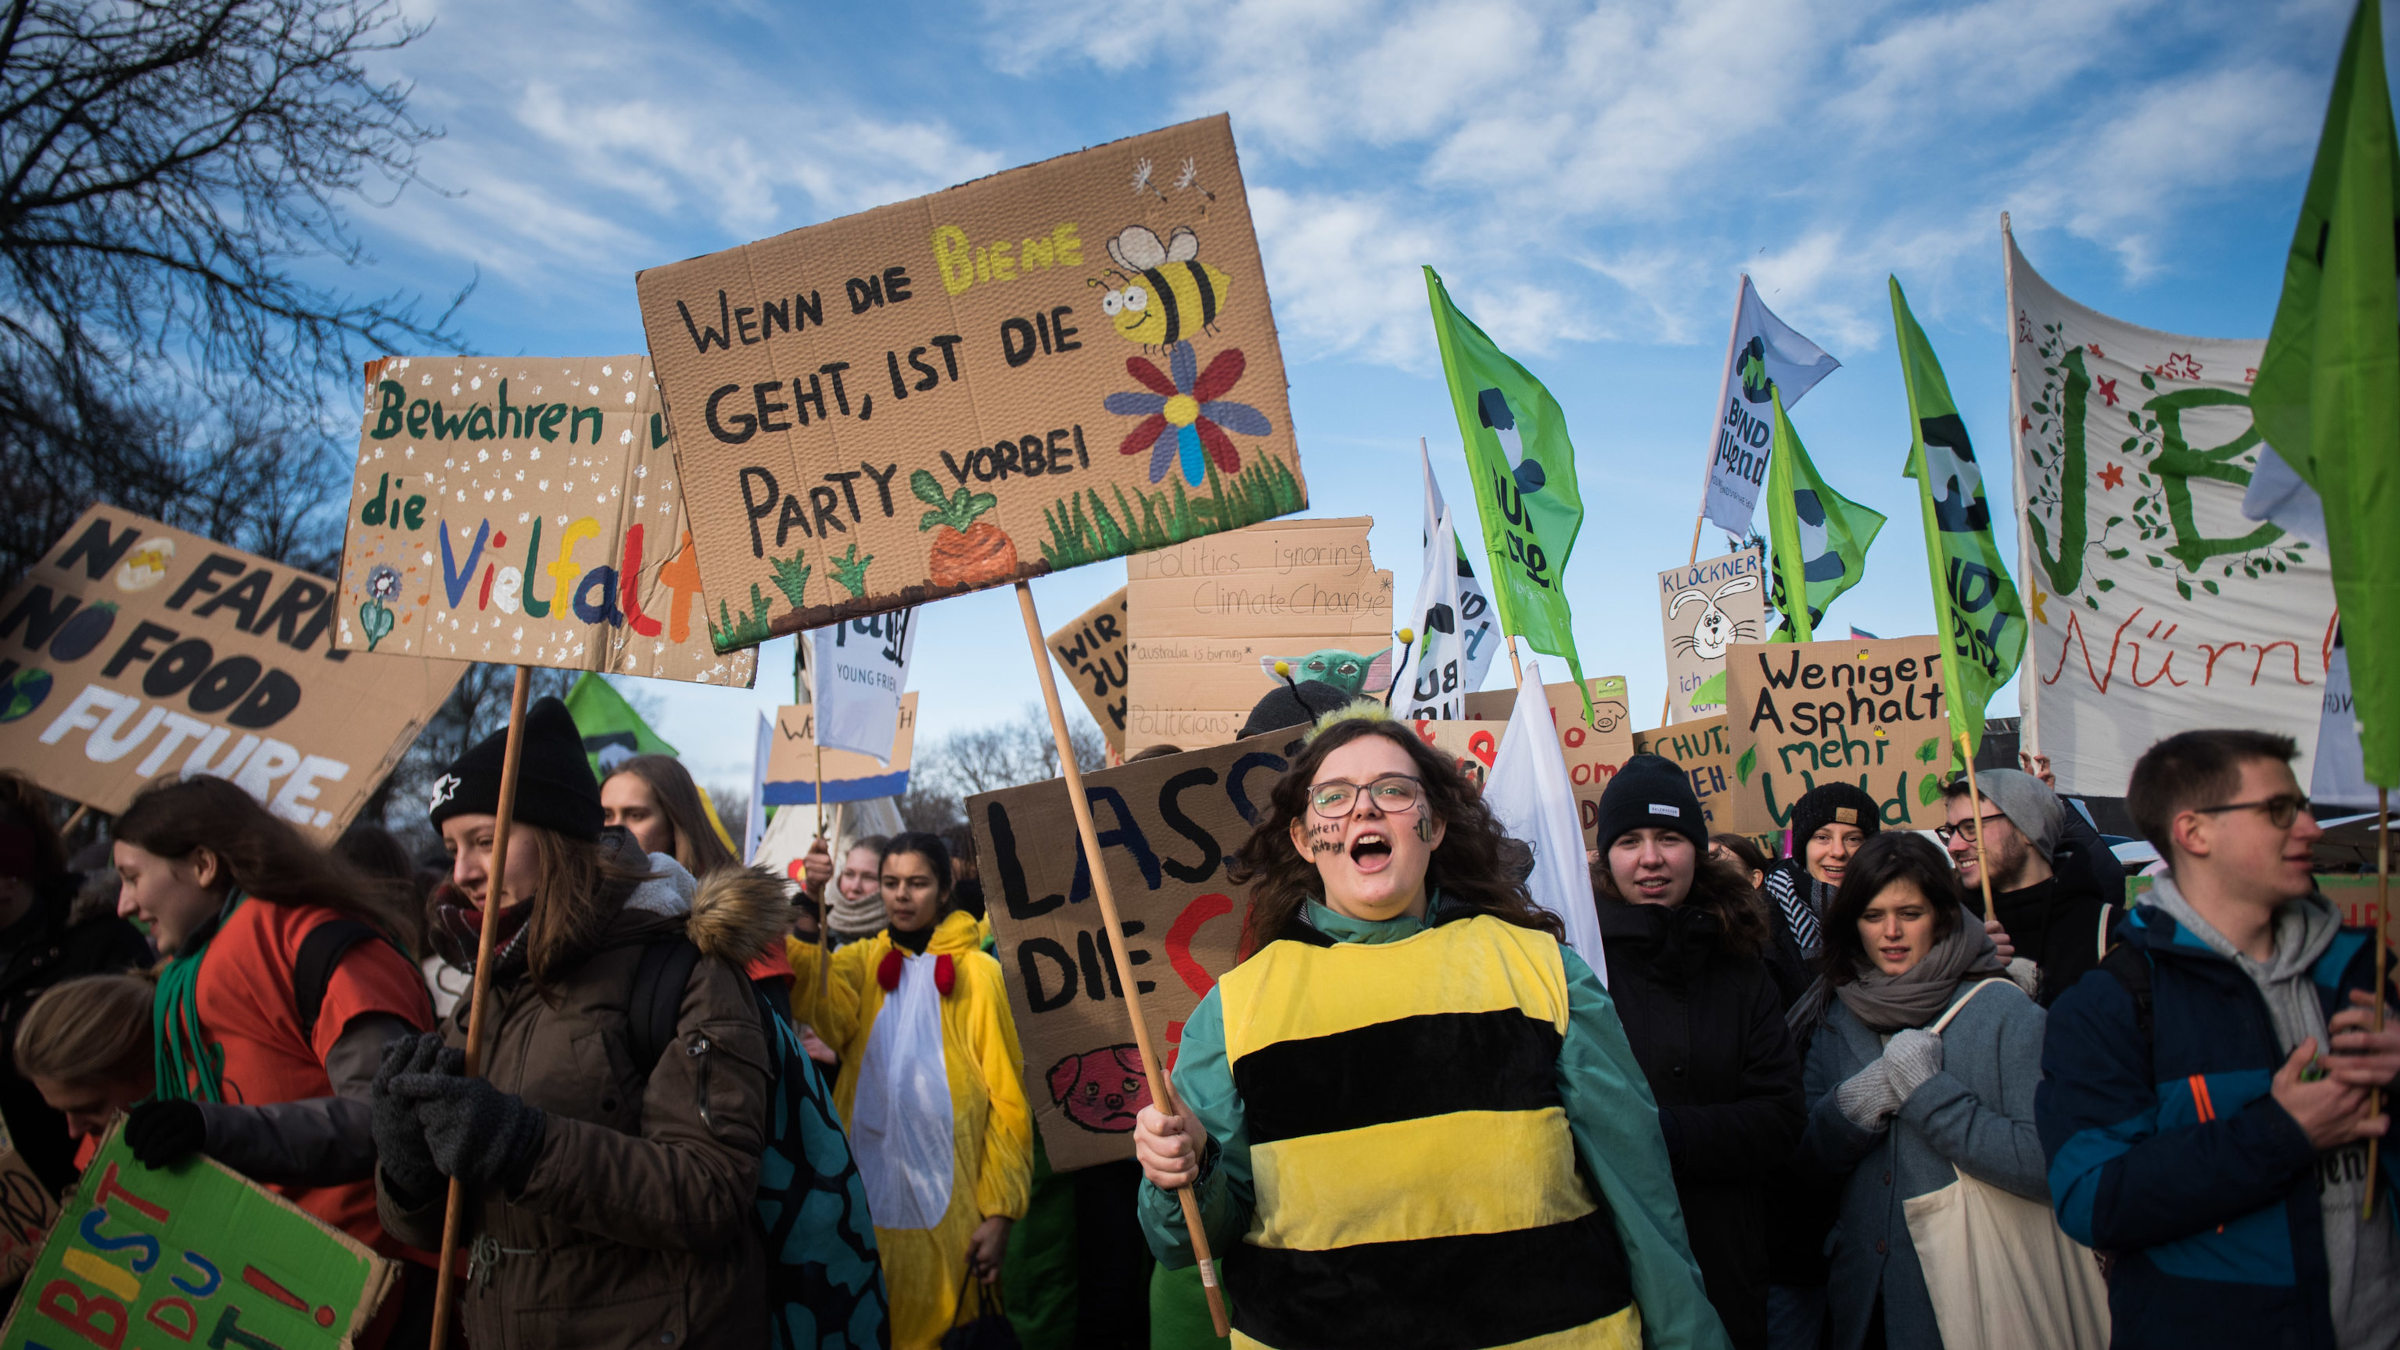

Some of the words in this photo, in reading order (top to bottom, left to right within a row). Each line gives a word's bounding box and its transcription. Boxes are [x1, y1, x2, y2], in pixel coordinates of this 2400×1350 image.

[677, 287, 824, 354] WENN
[846, 266, 912, 314] DIE
[931, 222, 1084, 296] BIENE
[705, 361, 874, 444] GEHT,
[887, 334, 963, 399] IST
[1000, 305, 1082, 368] DIE
[370, 378, 601, 446] Bewahren
[361, 473, 426, 531] die
[739, 461, 898, 559] PARTY
[940, 424, 1089, 484] VORBEI
[1274, 540, 1363, 576] ignoring
[1662, 555, 1758, 593] KLÖCKNER
[1058, 613, 1122, 668] WIR
[1194, 644, 1204, 660] is
[2043, 606, 2340, 696] Nürn
[101, 619, 302, 730] FOOD
[837, 663, 874, 685] YOUNG
[1759, 650, 1943, 695] Weniger
[1750, 684, 1944, 738] Asphalt
[1777, 723, 1890, 775] mehr
[1017, 920, 1156, 1013] DIE
[147, 1250, 222, 1342] DU
